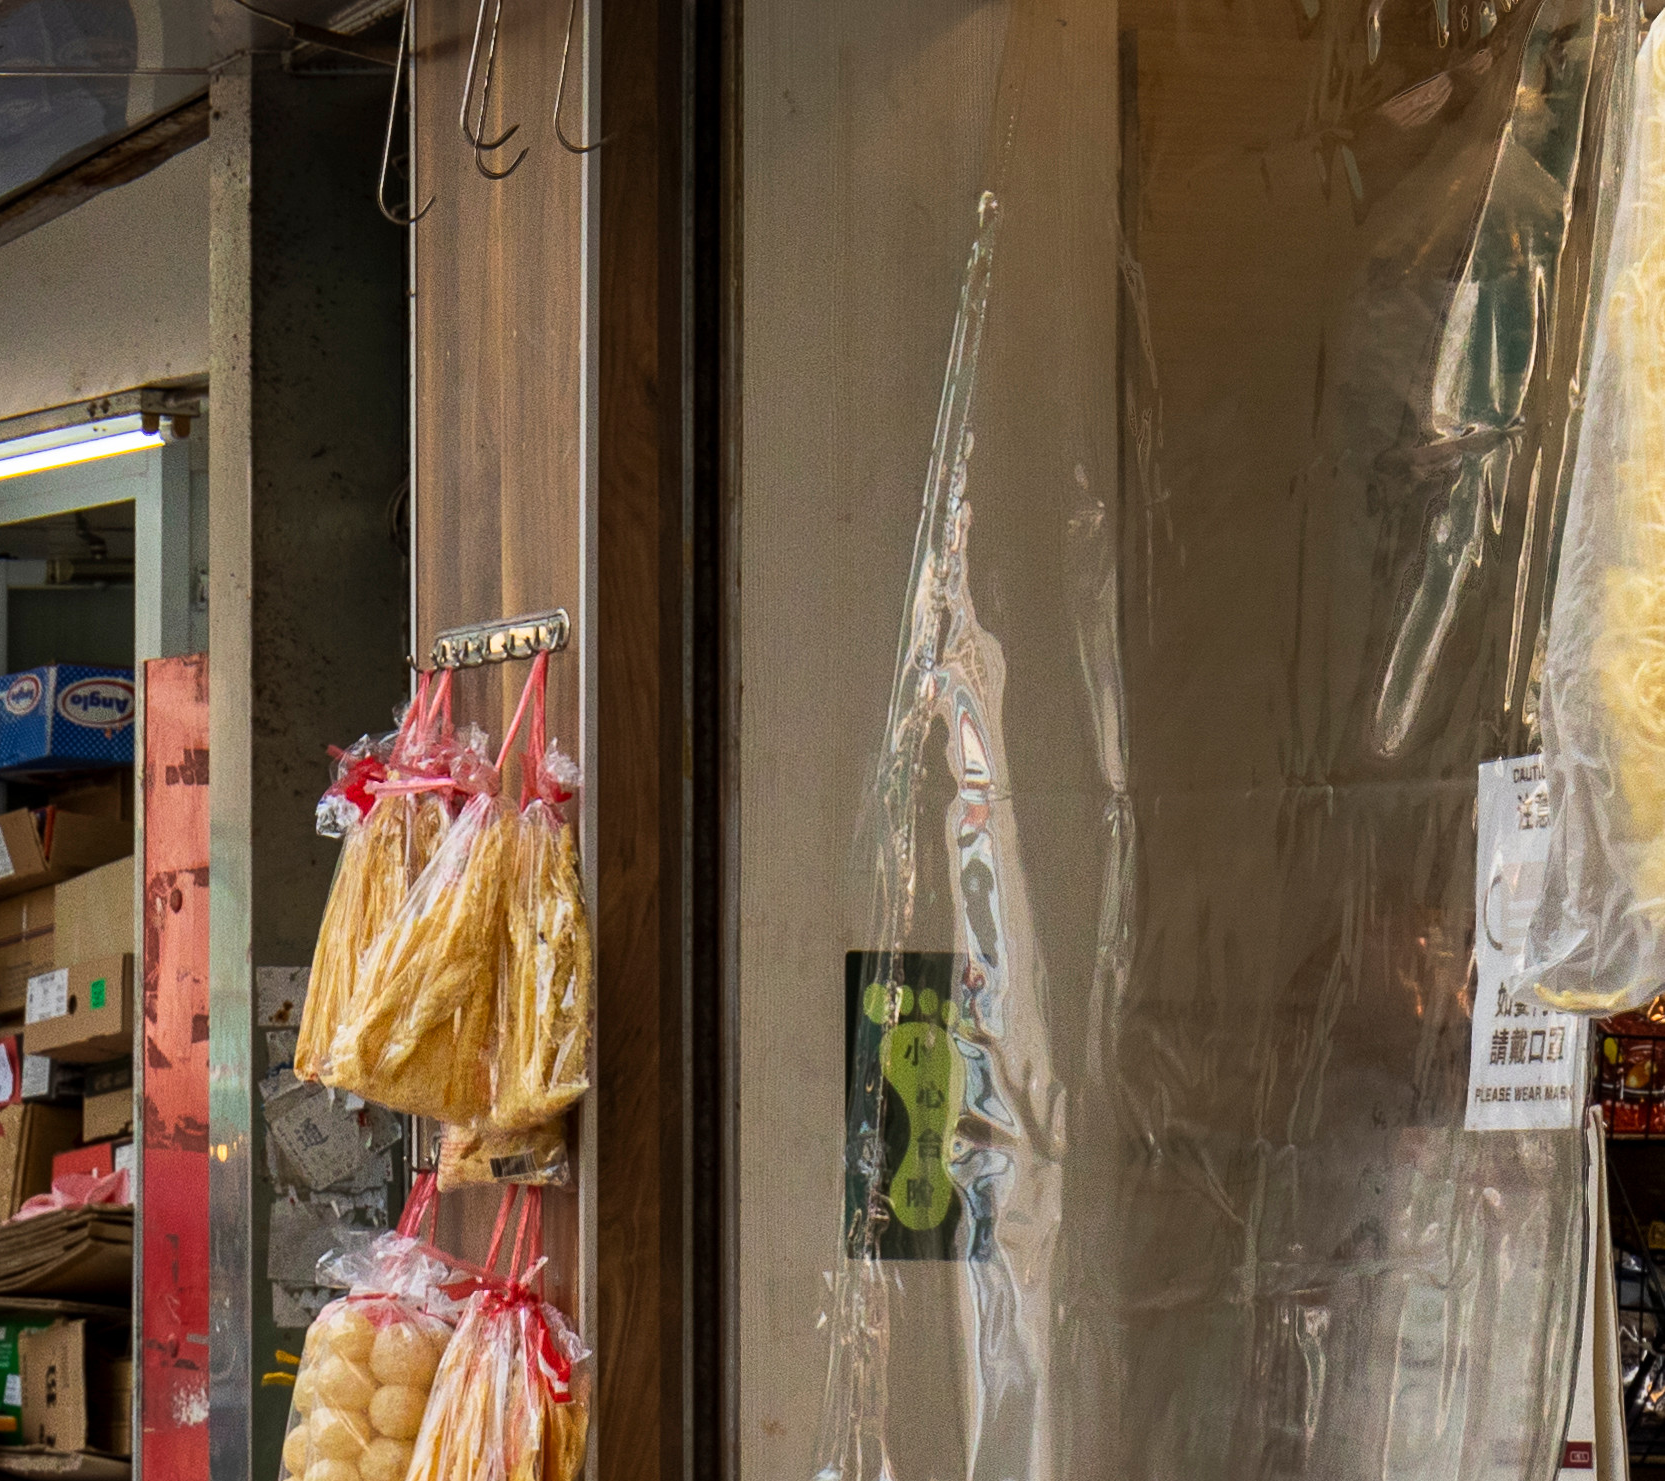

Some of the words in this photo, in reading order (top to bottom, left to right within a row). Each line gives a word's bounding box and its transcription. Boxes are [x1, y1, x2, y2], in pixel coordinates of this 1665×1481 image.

[71, 688, 130, 714] Anglo
[1512, 766, 1548, 784] CAUTI
[1488, 1026, 1567, 1068] 請戴口罩
[1474, 1083, 1513, 1103] PLEASE
[1515, 1084, 1544, 1103] WEAR
